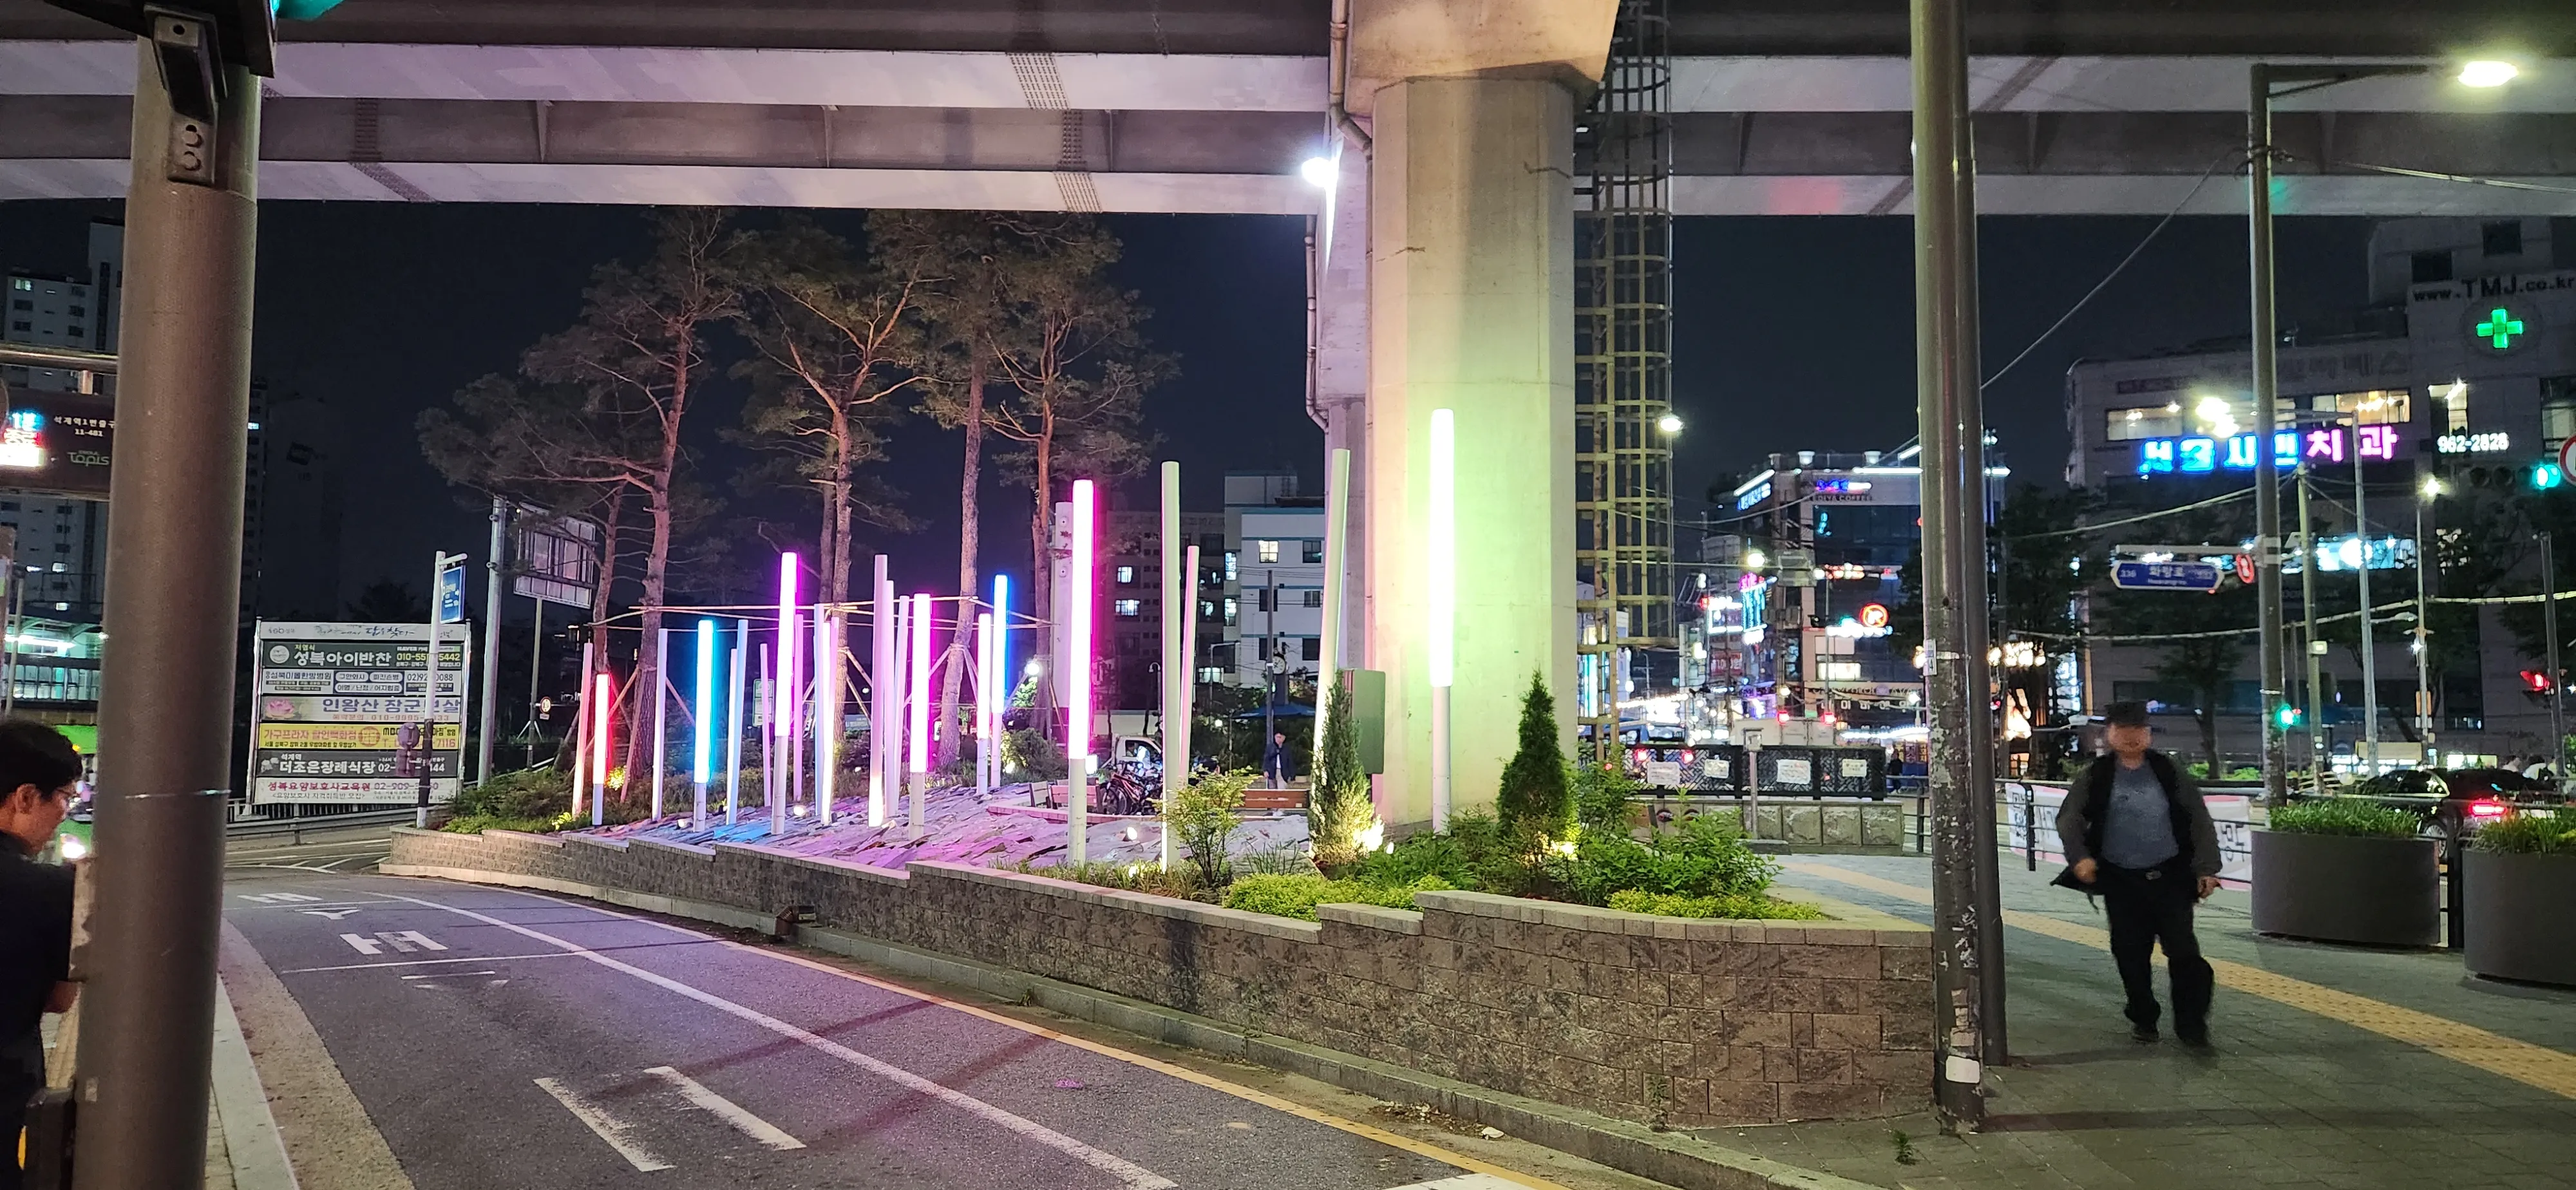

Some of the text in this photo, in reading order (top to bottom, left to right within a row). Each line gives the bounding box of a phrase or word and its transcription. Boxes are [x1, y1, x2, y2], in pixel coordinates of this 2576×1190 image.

[294, 651, 392, 666] 성북아이반찬
[323, 699, 379, 712] 인왕산
[279, 760, 376, 775] 더조은장례식장
